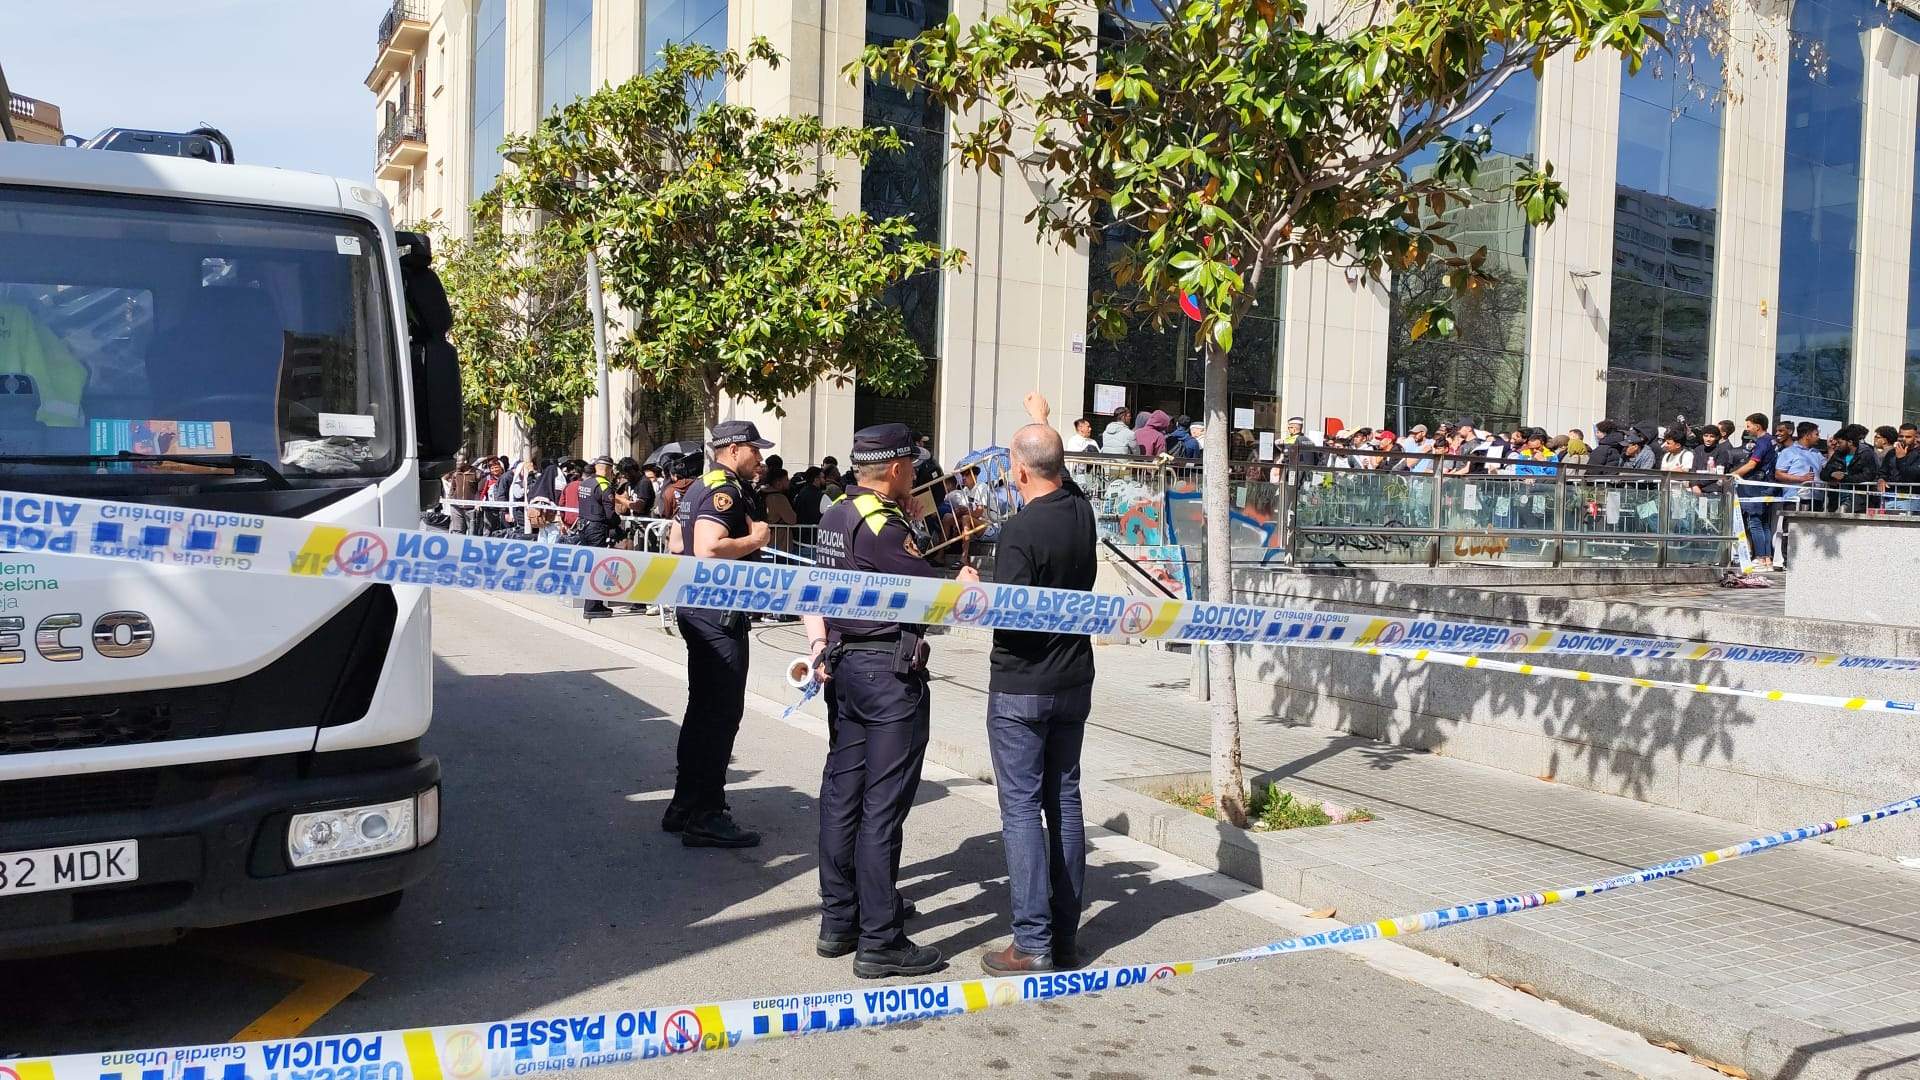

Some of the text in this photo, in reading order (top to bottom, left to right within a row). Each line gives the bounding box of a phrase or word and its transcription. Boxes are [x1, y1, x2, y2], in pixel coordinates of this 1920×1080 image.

[817, 528, 844, 549] POLICIA
[0, 561, 35, 575] em
[0, 594, 19, 612] ja
[53, 847, 126, 884] MDK
[1023, 967, 1147, 999] NO PASSEU
[752, 986, 949, 1014] POLICIA Guàrdia Urbana
[487, 1010, 657, 1050] NO PASSEU
[101, 1036, 383, 1070] POLICIA Guàrdia Urbana
